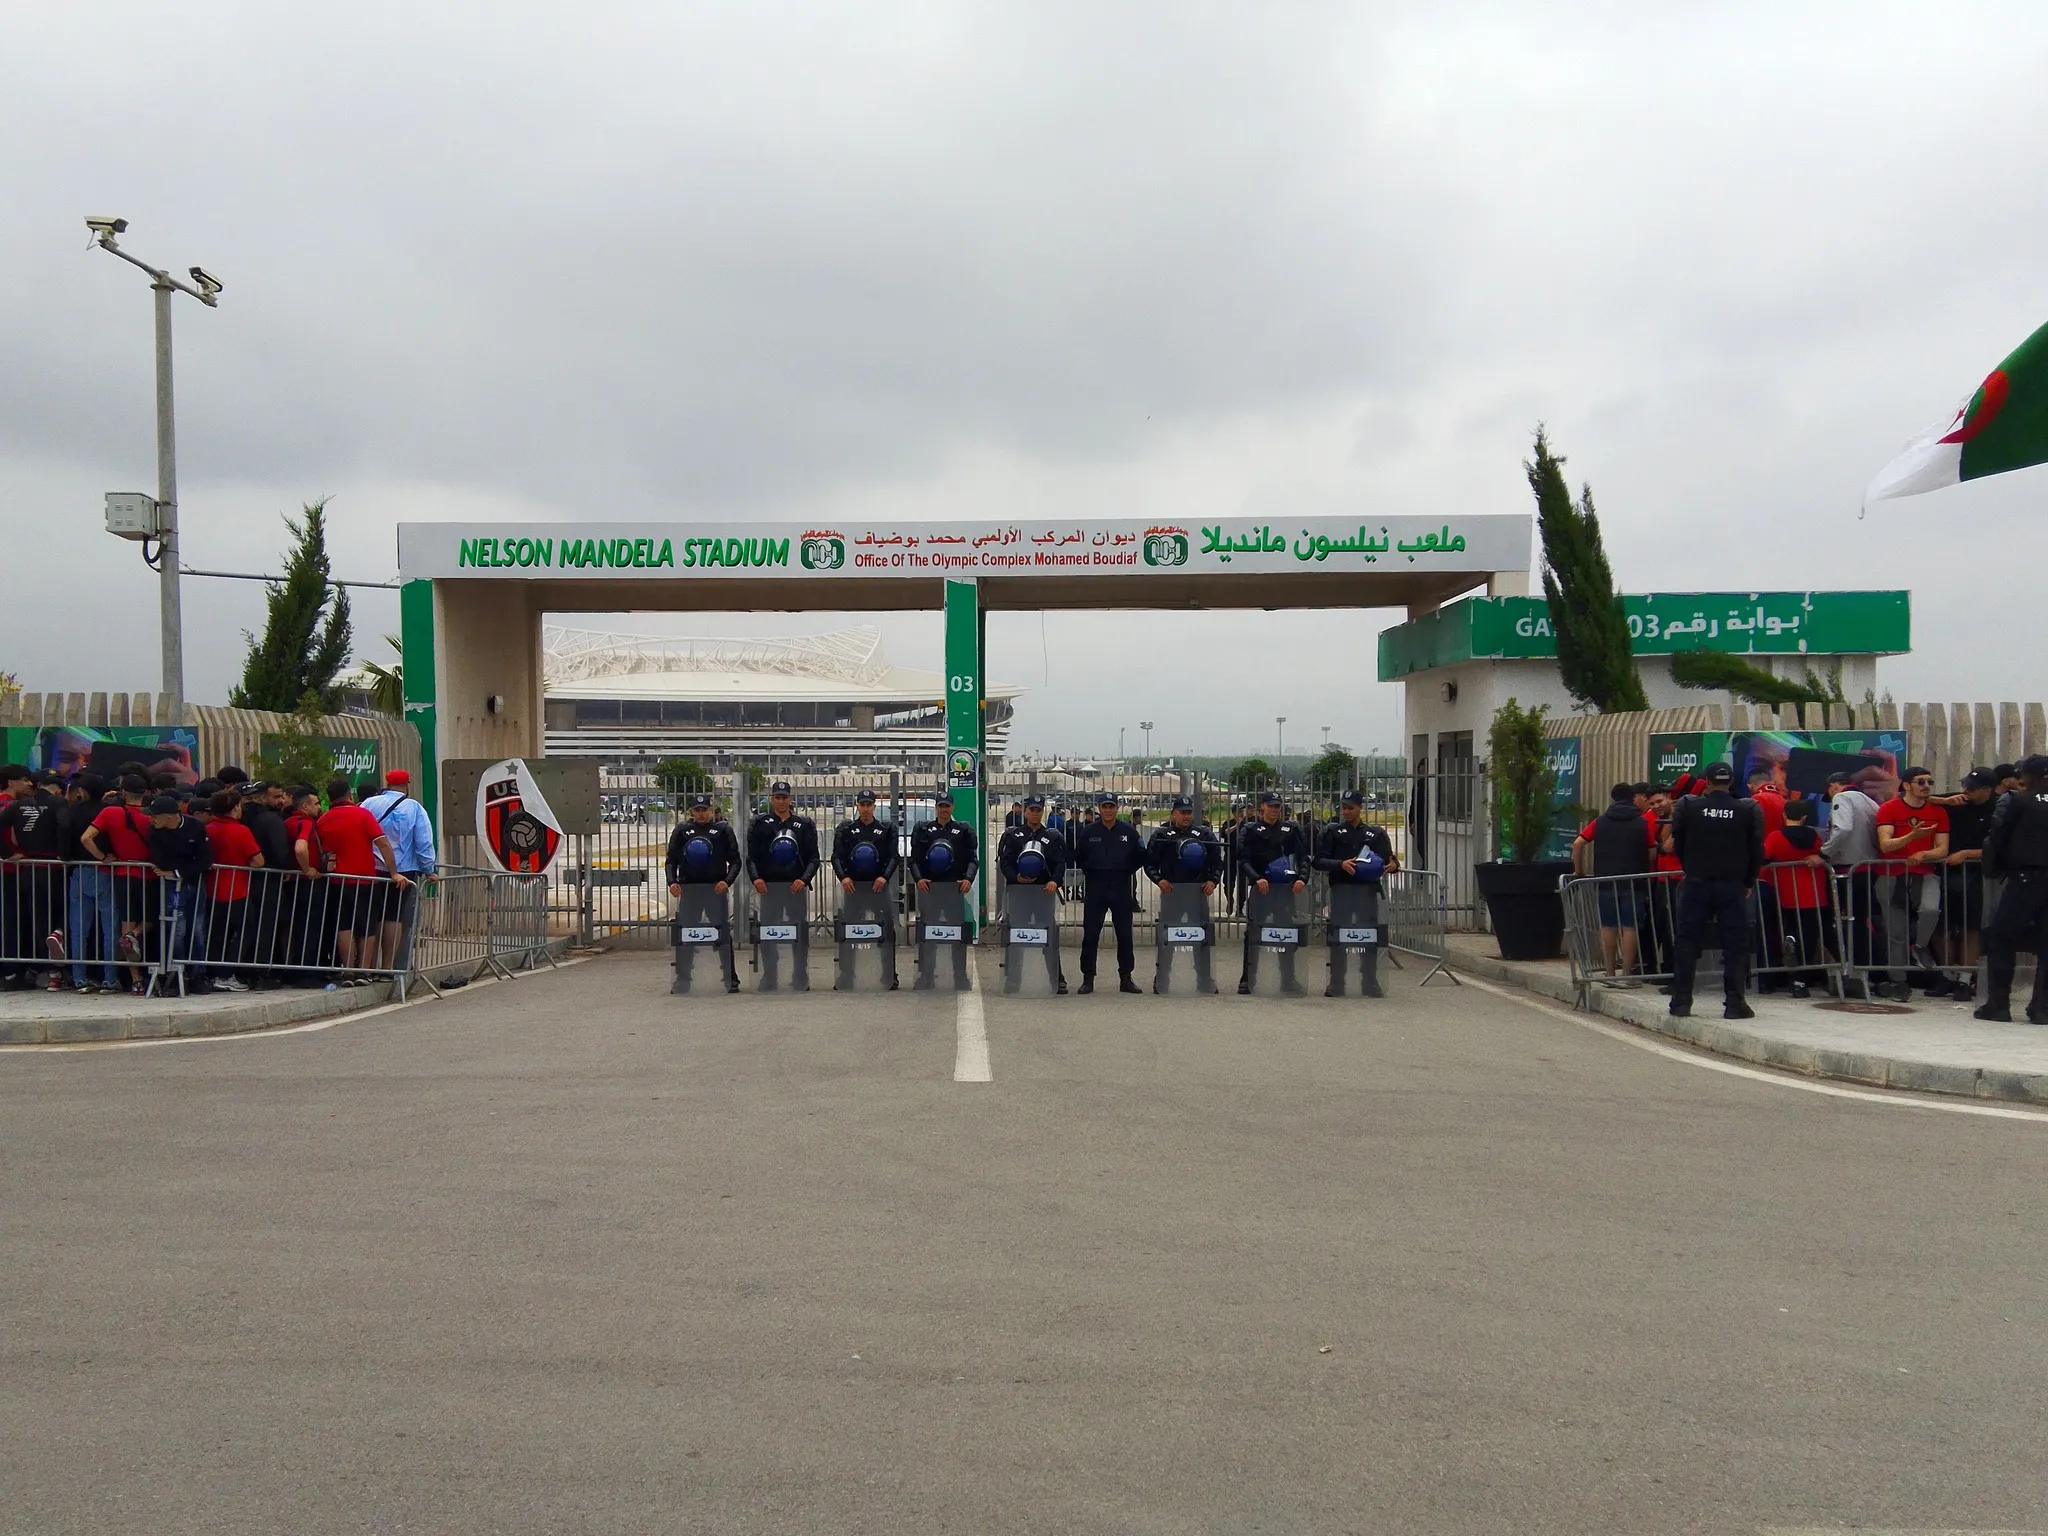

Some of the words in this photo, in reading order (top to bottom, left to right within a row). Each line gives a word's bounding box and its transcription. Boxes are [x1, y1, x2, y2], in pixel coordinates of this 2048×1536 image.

[853, 530, 920, 548] بوضياف
[926, 531, 967, 546] محمد
[971, 525, 1023, 549] الأولمبي
[1030, 528, 1085, 548] المركب
[1093, 530, 1136, 546] ديوان
[1200, 525, 1286, 564] مانديلا
[1292, 525, 1391, 563] نيلسون
[1395, 524, 1467, 563] ملعب
[457, 537, 553, 568] NELSON
[558, 537, 676, 569] MANDELA
[681, 537, 791, 568] STADIUM
[854, 553, 889, 568] Office
[891, 553, 905, 567] Of
[908, 553, 930, 567] The
[931, 552, 979, 570] Olympic
[981, 552, 1032, 569] Complex
[1034, 551, 1090, 566] Mohamed
[1093, 550, 1138, 565] Boudiaf
[1628, 614, 1660, 638] 03
[1663, 612, 1719, 640] رقم
[1726, 606, 1800, 636] بوابة
[951, 676, 973, 692] 03
[1657, 747, 1698, 772] موبيليس
[1702, 807, 1735, 819] 1-8/151
[687, 928, 712, 941] شرطة
[765, 926, 791, 939] شرطة
[851, 924, 876, 937] شرطة
[931, 926, 956, 939] شرطة
[1016, 931, 1041, 942] شرطة
[1174, 928, 1199, 940] شرطة
[1268, 929, 1292, 942] شرطة
[1346, 930, 1371, 942] شرطة
